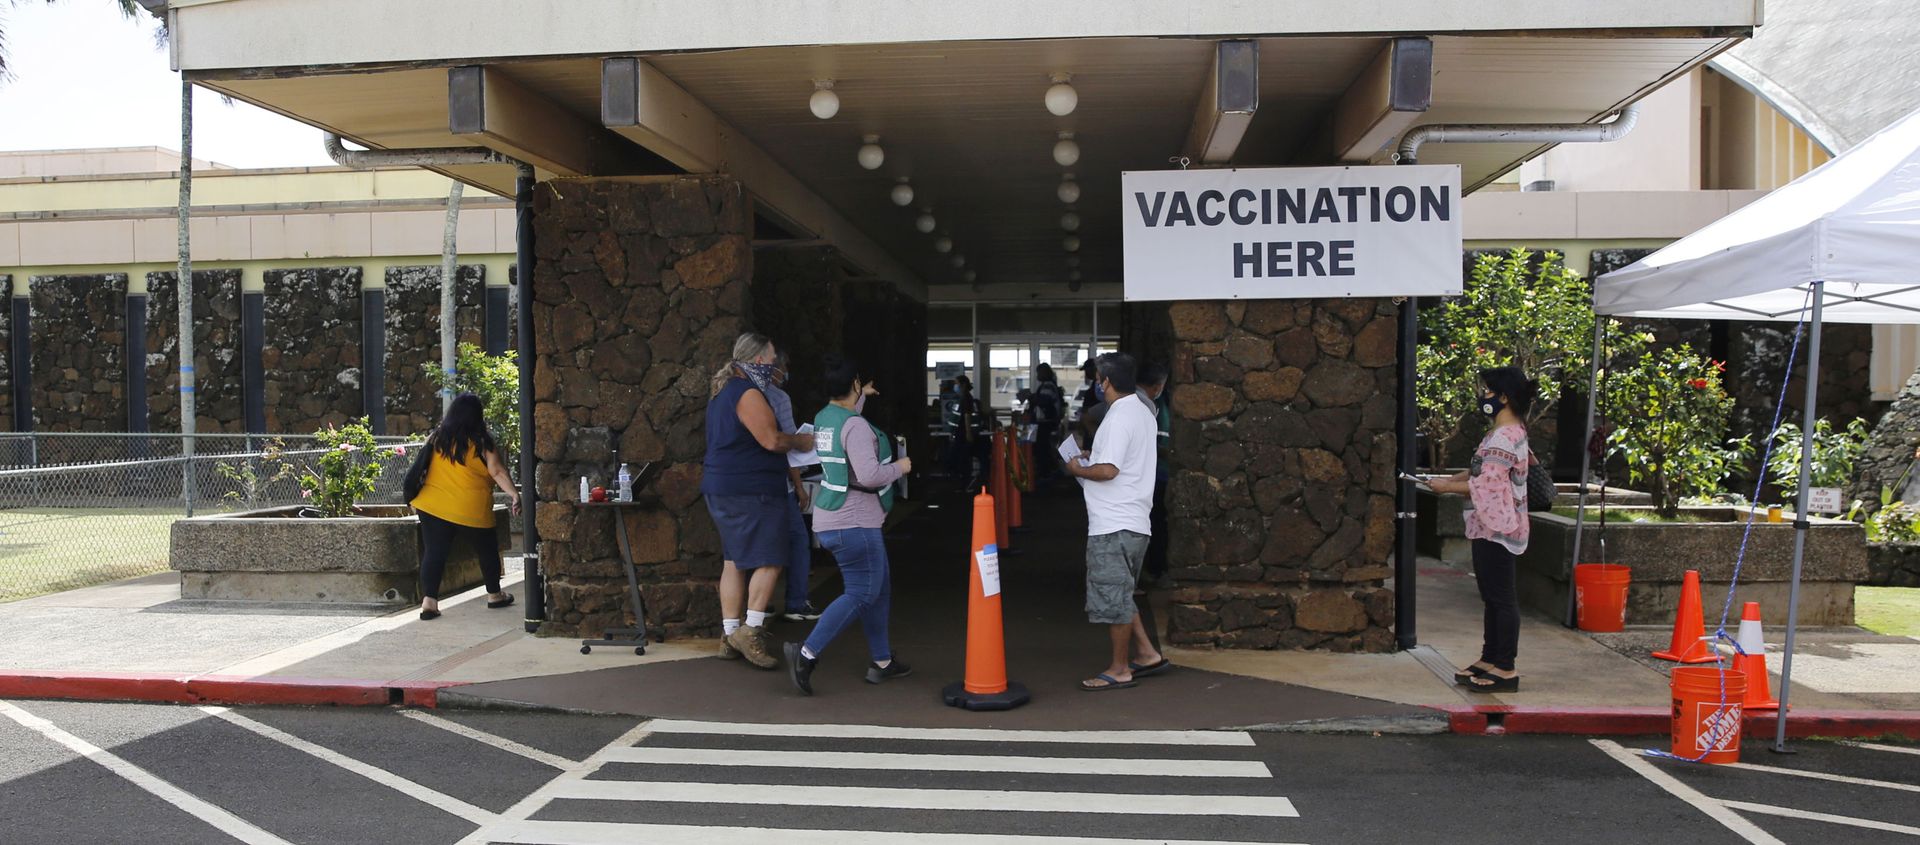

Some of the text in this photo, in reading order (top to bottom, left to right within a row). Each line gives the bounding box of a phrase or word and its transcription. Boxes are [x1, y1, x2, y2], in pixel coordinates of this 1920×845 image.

[1135, 185, 1450, 227] VACCINATION
[1233, 240, 1356, 278] HERE
[1696, 703, 1741, 750] HOME
[1702, 709, 1724, 727] THE
